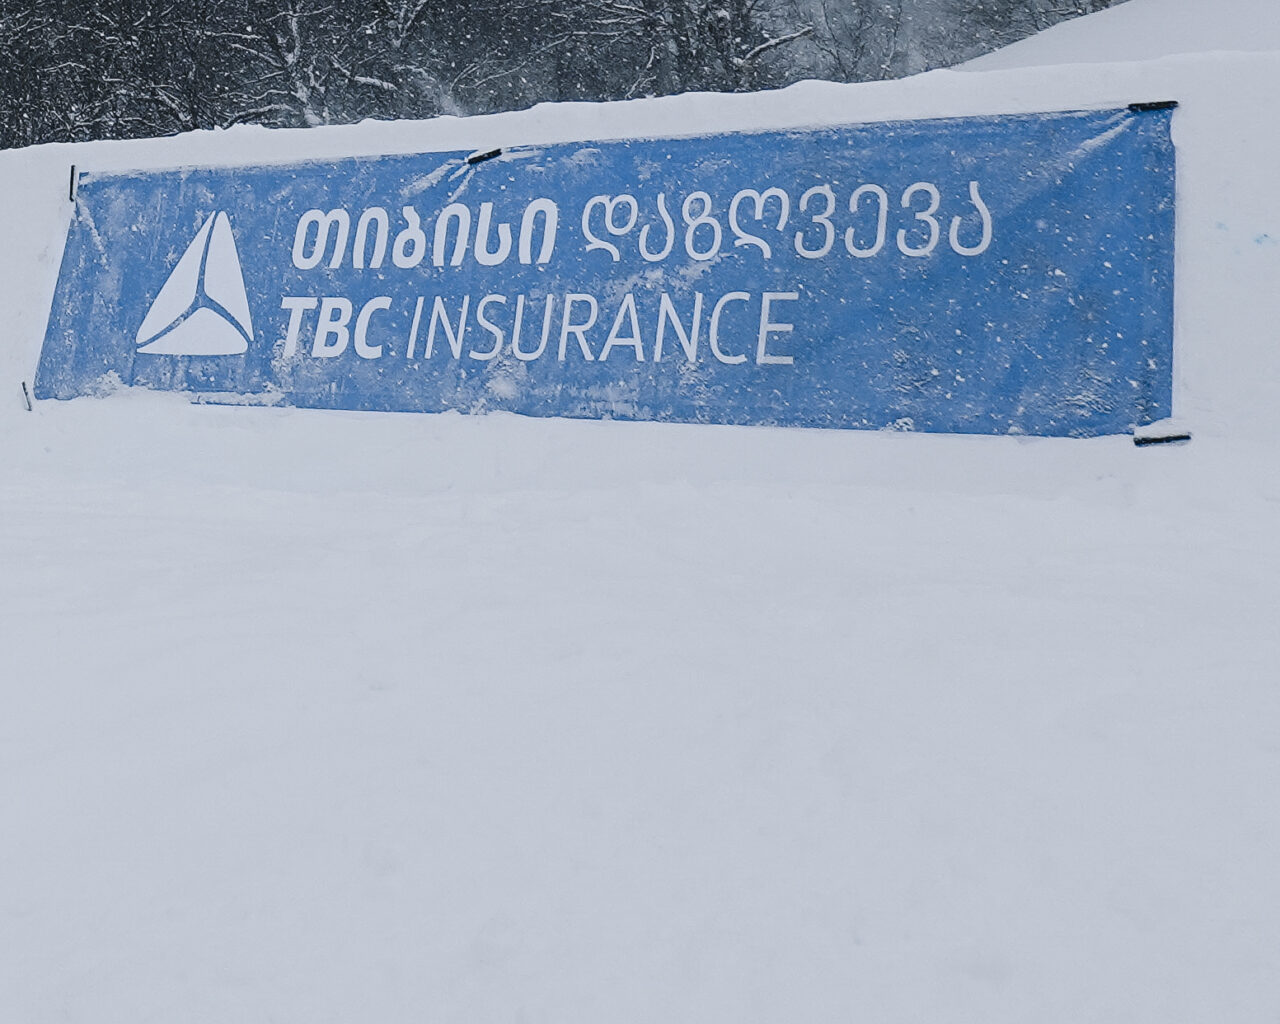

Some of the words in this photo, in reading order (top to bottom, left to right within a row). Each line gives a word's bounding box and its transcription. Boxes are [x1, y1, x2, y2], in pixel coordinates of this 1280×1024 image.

[292, 197, 558, 270] თიბისი
[581, 180, 992, 262] დაზღვევა
[280, 296, 393, 360] TBC
[406, 290, 800, 365] INSURANCE
